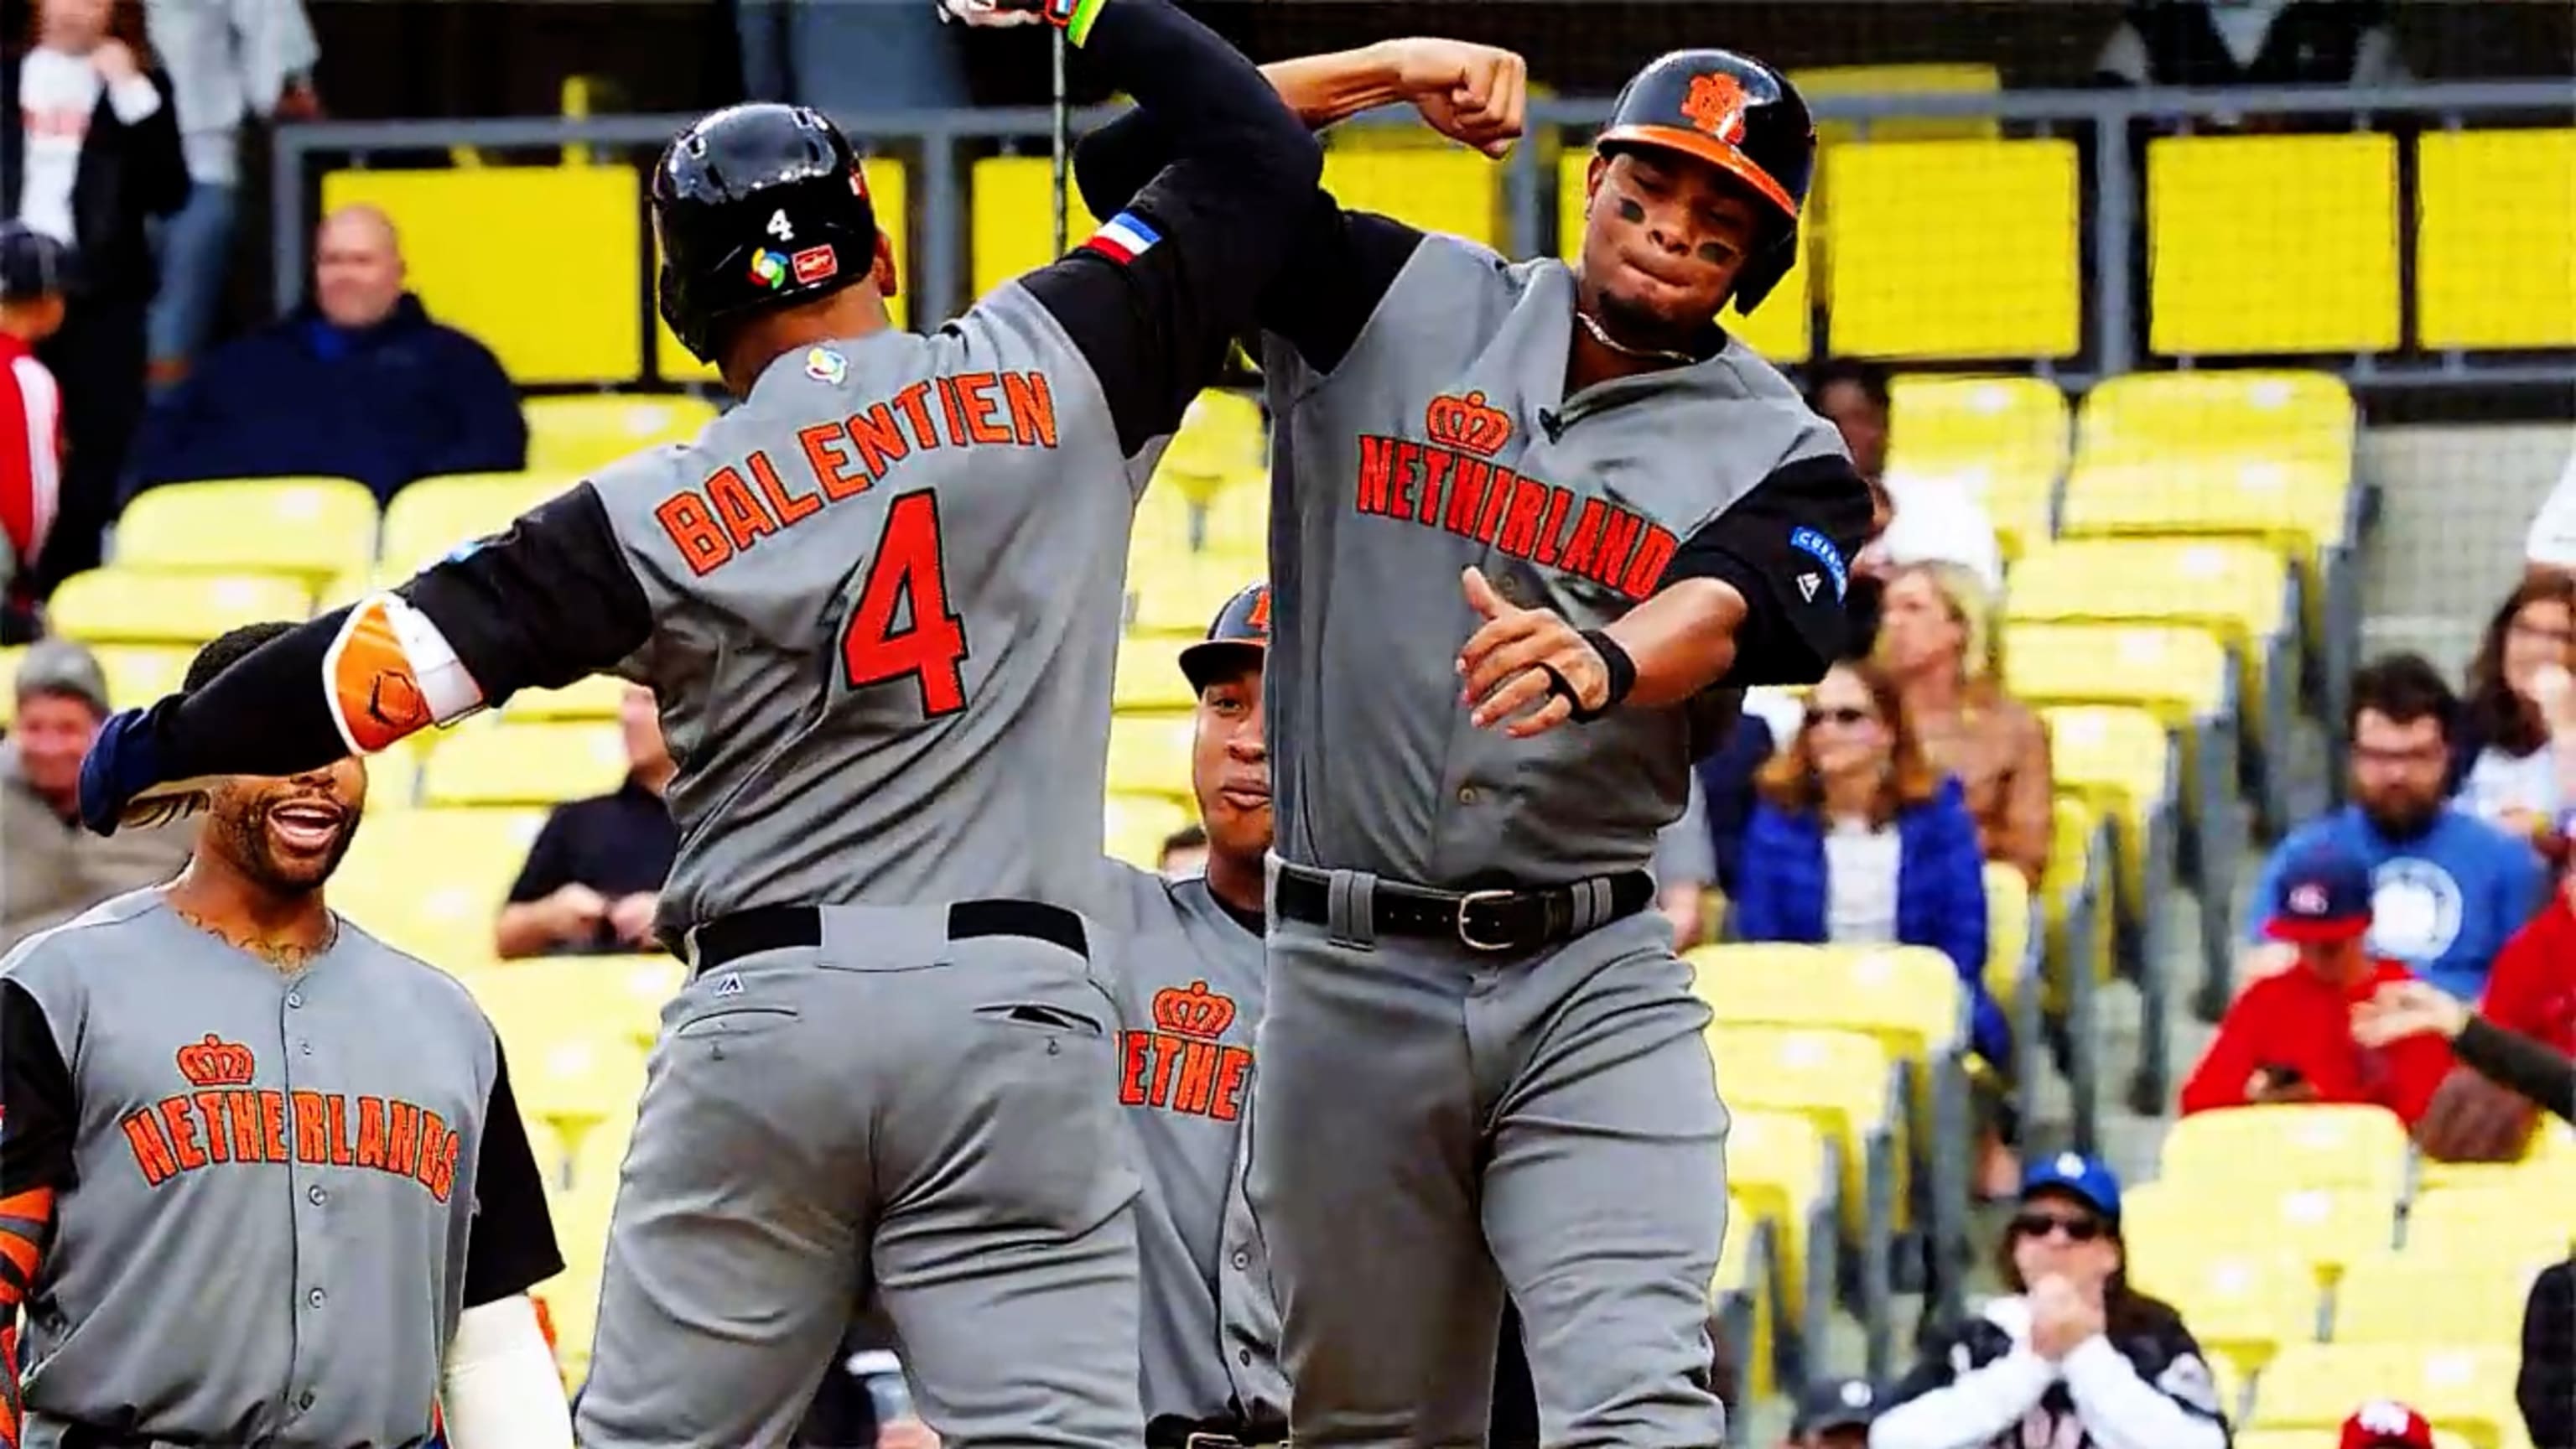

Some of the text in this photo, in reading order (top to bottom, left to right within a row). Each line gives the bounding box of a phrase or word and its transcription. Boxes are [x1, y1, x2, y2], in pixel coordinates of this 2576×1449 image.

[766, 209, 794, 242] 4
[656, 371, 1057, 577] BALENTIEN
[841, 487, 968, 719] 4
[1117, 1030, 1254, 1121] ETHE
[122, 1089, 460, 1203] NETHERLANDS
